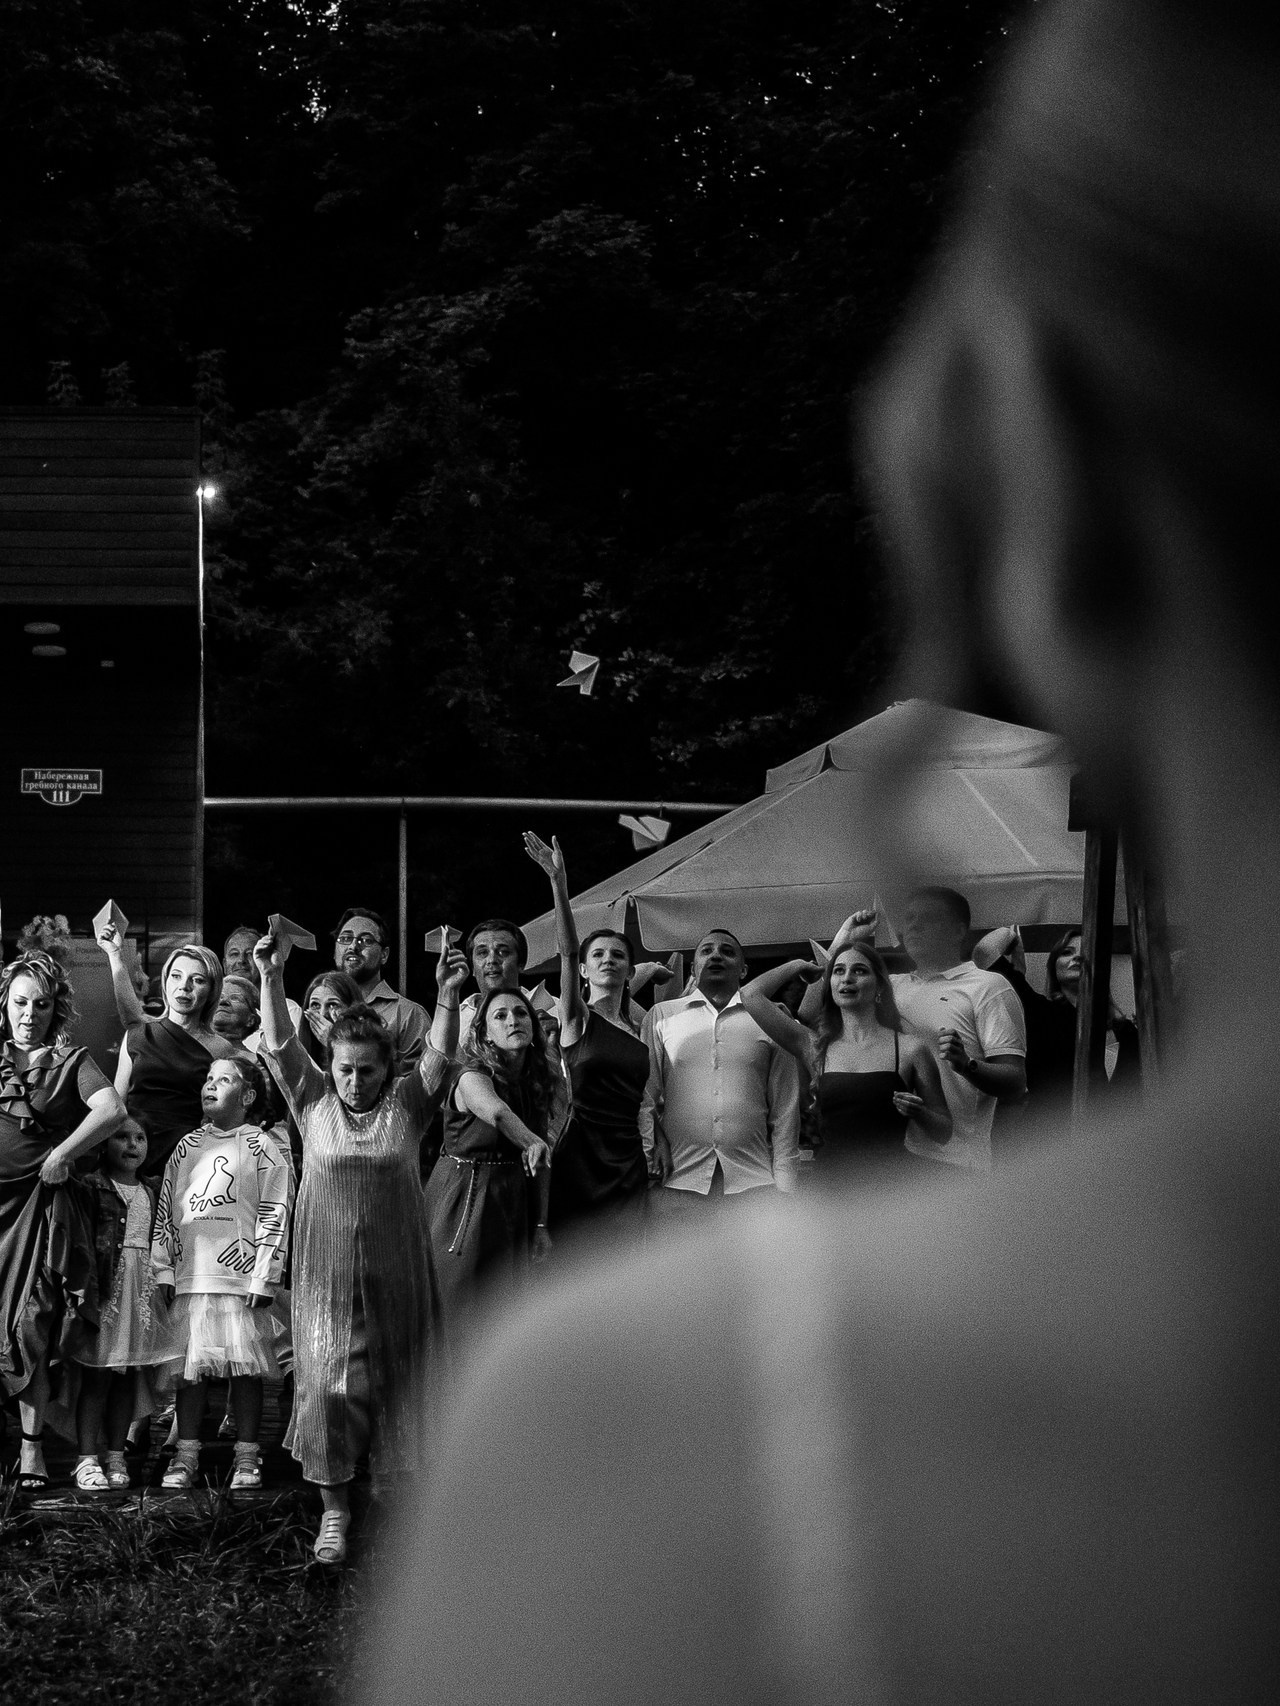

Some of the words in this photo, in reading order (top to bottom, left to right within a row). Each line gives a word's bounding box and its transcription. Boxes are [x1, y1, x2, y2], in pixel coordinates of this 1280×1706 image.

[34, 771, 89, 782] Набережная
[25, 781, 64, 790] гребного
[66, 782, 98, 790] канала
[52, 790, 70, 803] 111
